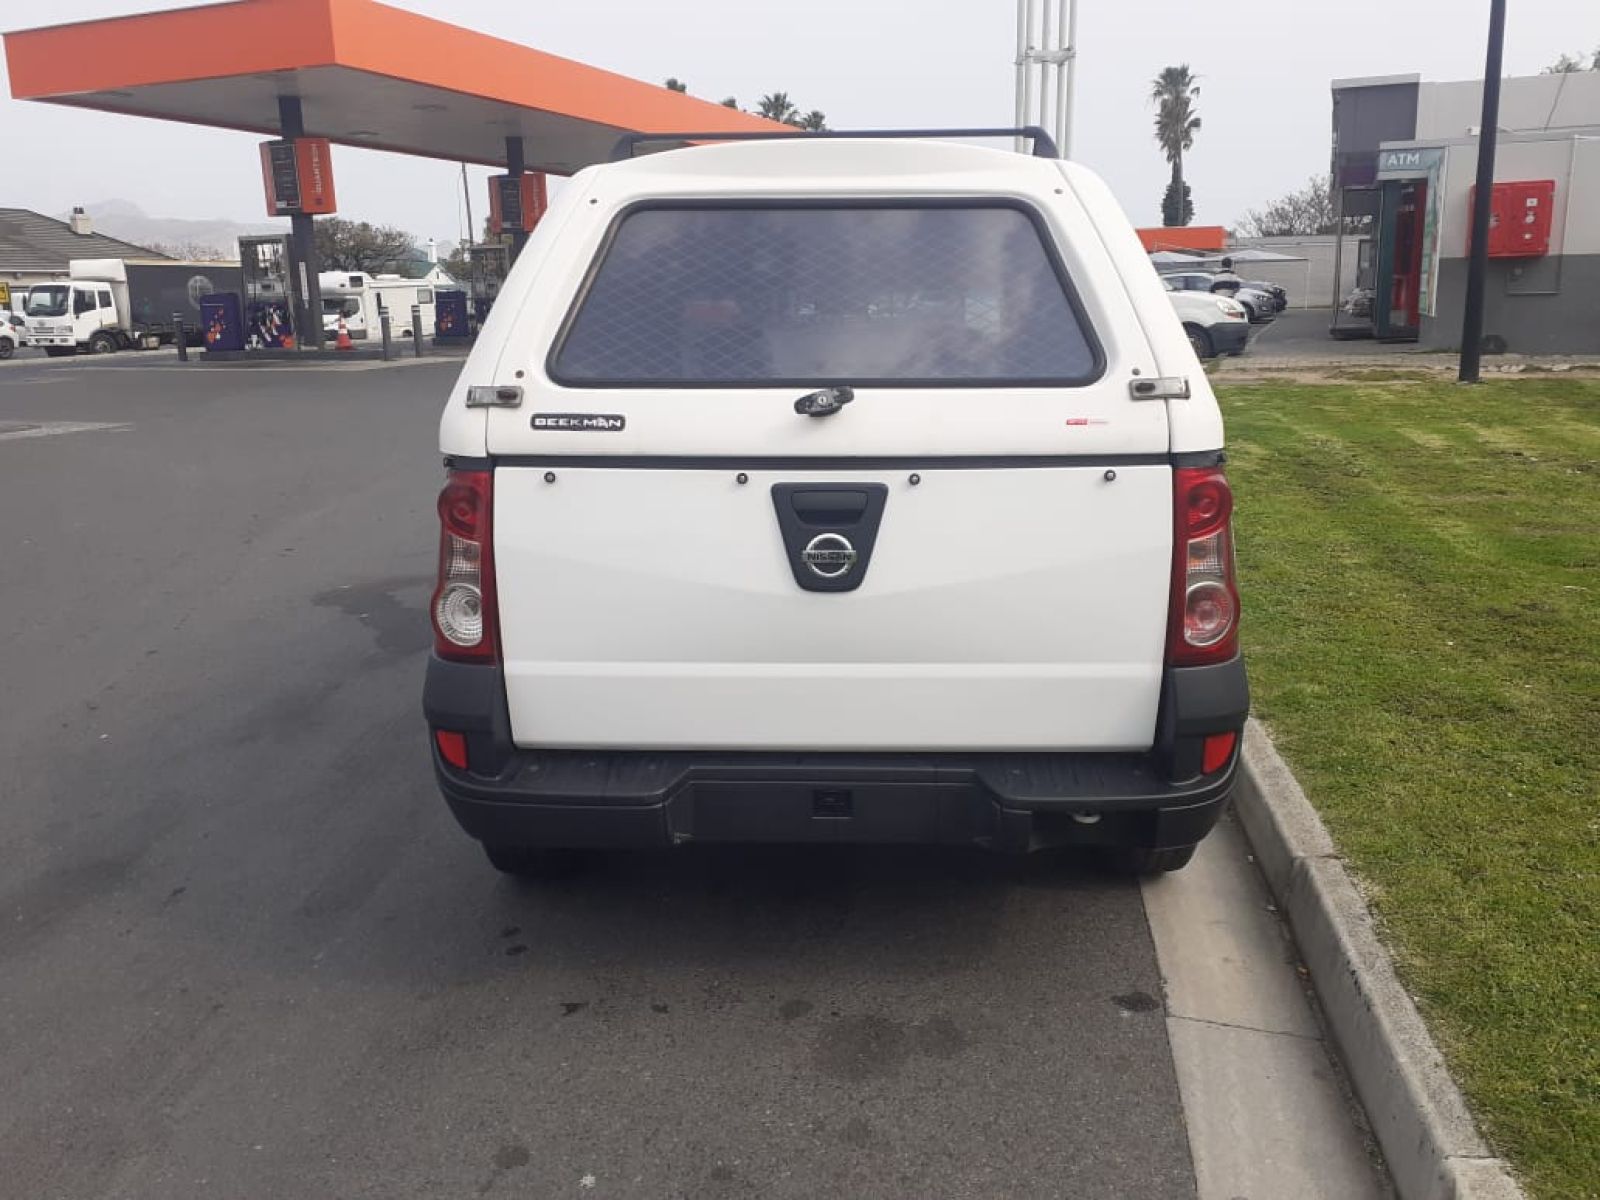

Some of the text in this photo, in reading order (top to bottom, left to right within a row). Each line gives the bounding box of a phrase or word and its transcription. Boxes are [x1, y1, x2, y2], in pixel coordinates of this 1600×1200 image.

[1387, 152, 1420, 168] ATM
[534, 416, 621, 428] BEEKMAN
[806, 552, 852, 561] NISSAN
